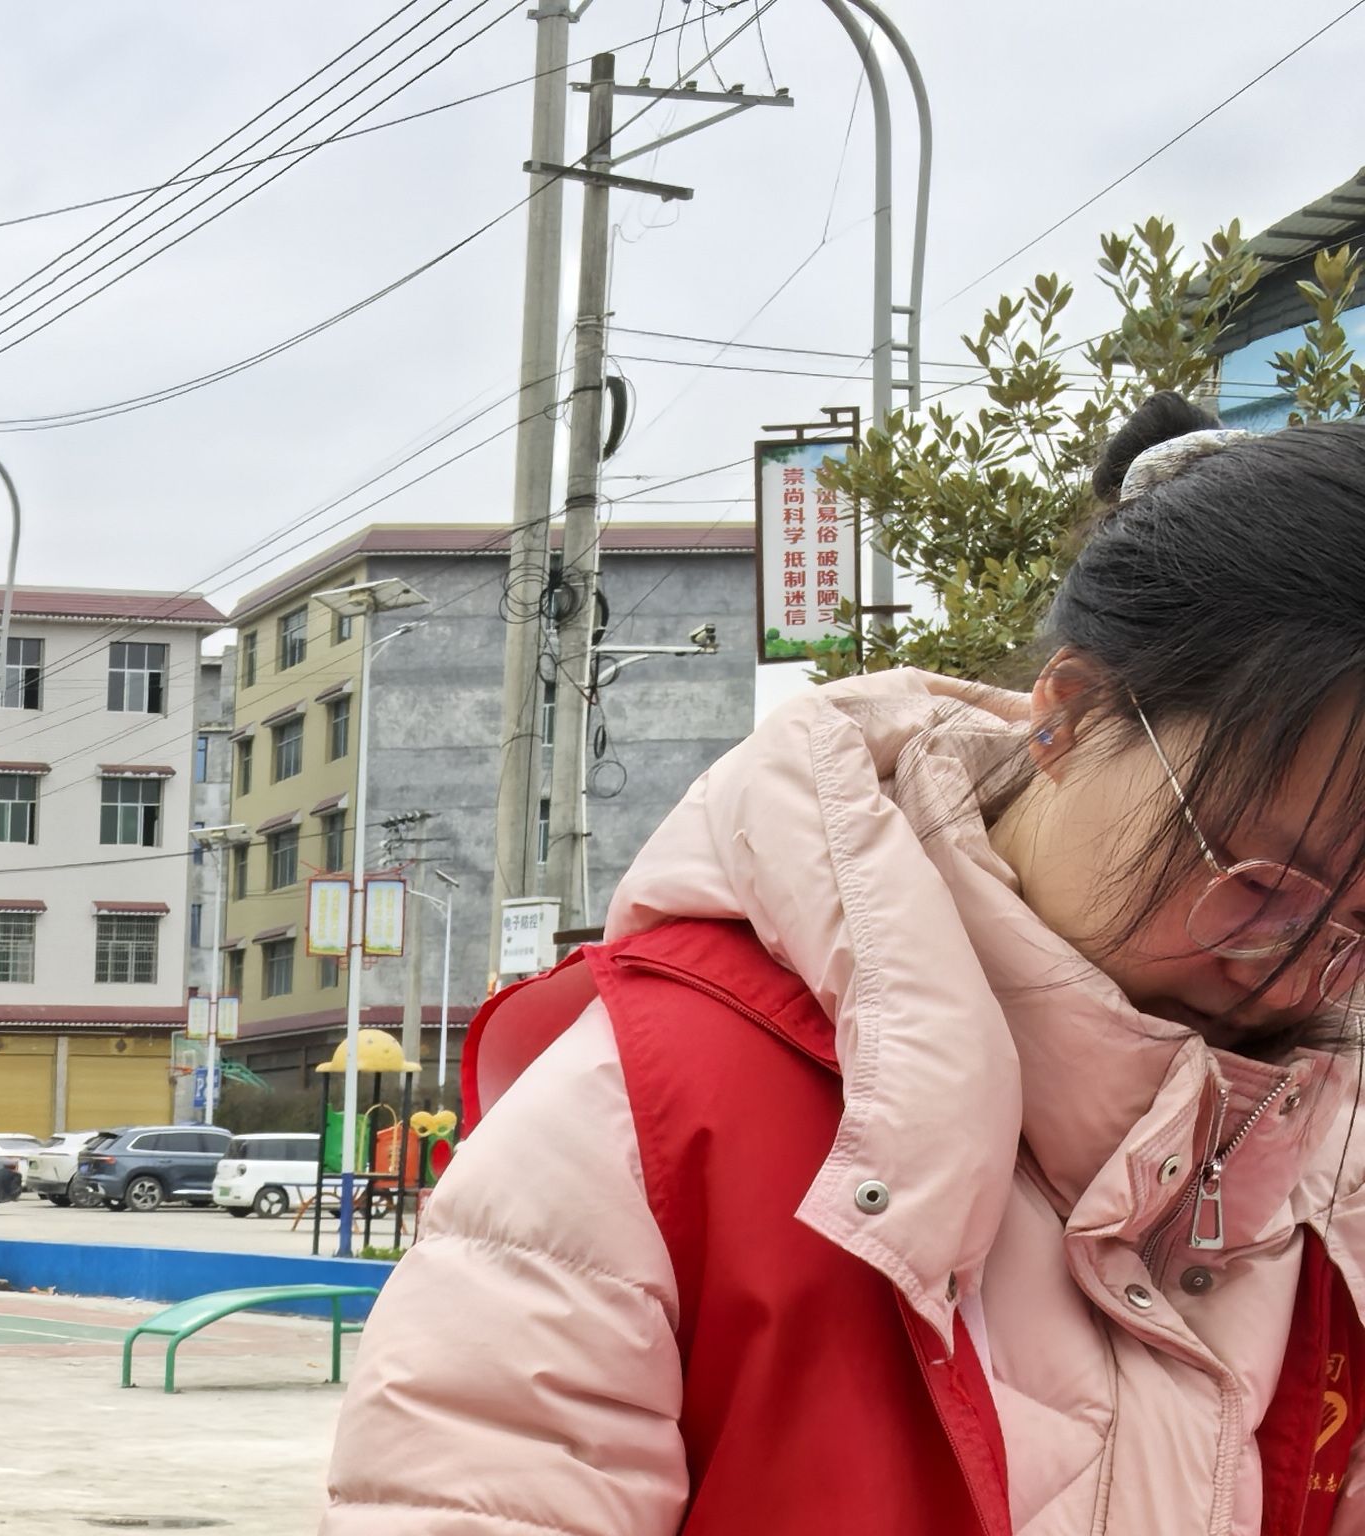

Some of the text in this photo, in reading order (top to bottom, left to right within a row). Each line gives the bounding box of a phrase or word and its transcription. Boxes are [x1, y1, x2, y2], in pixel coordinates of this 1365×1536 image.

[783, 468, 806, 626] 崇尚科学 抵制迷信
[816, 550, 838, 625] 破除陋习
